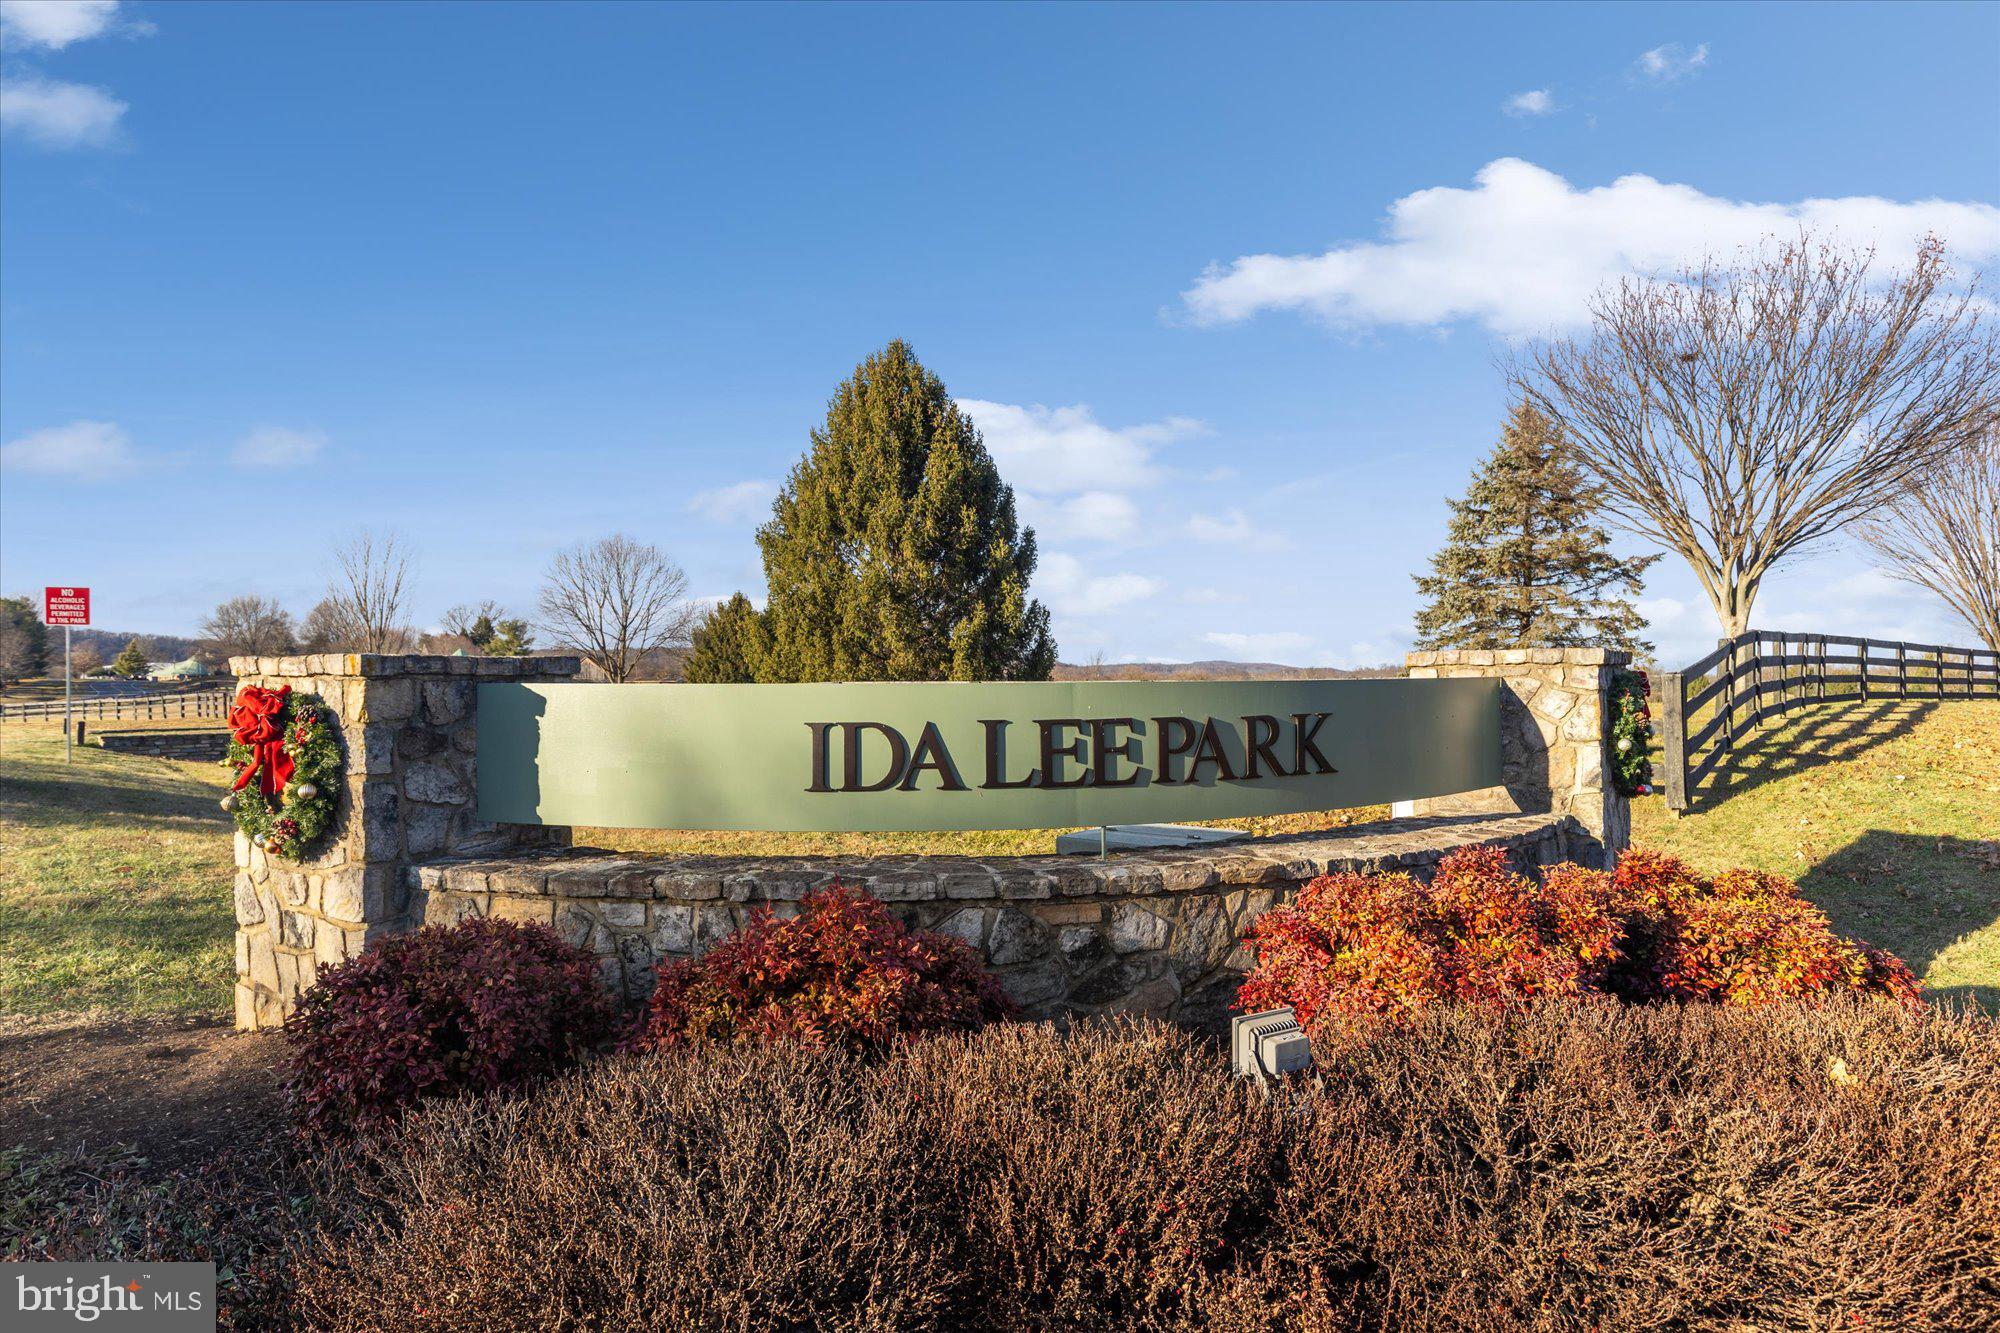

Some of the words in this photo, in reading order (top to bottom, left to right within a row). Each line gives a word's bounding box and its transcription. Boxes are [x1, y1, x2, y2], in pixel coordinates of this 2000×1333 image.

[804, 721, 972, 792] IDA
[977, 717, 1141, 789] LEE
[1151, 712, 1338, 785] PARK
